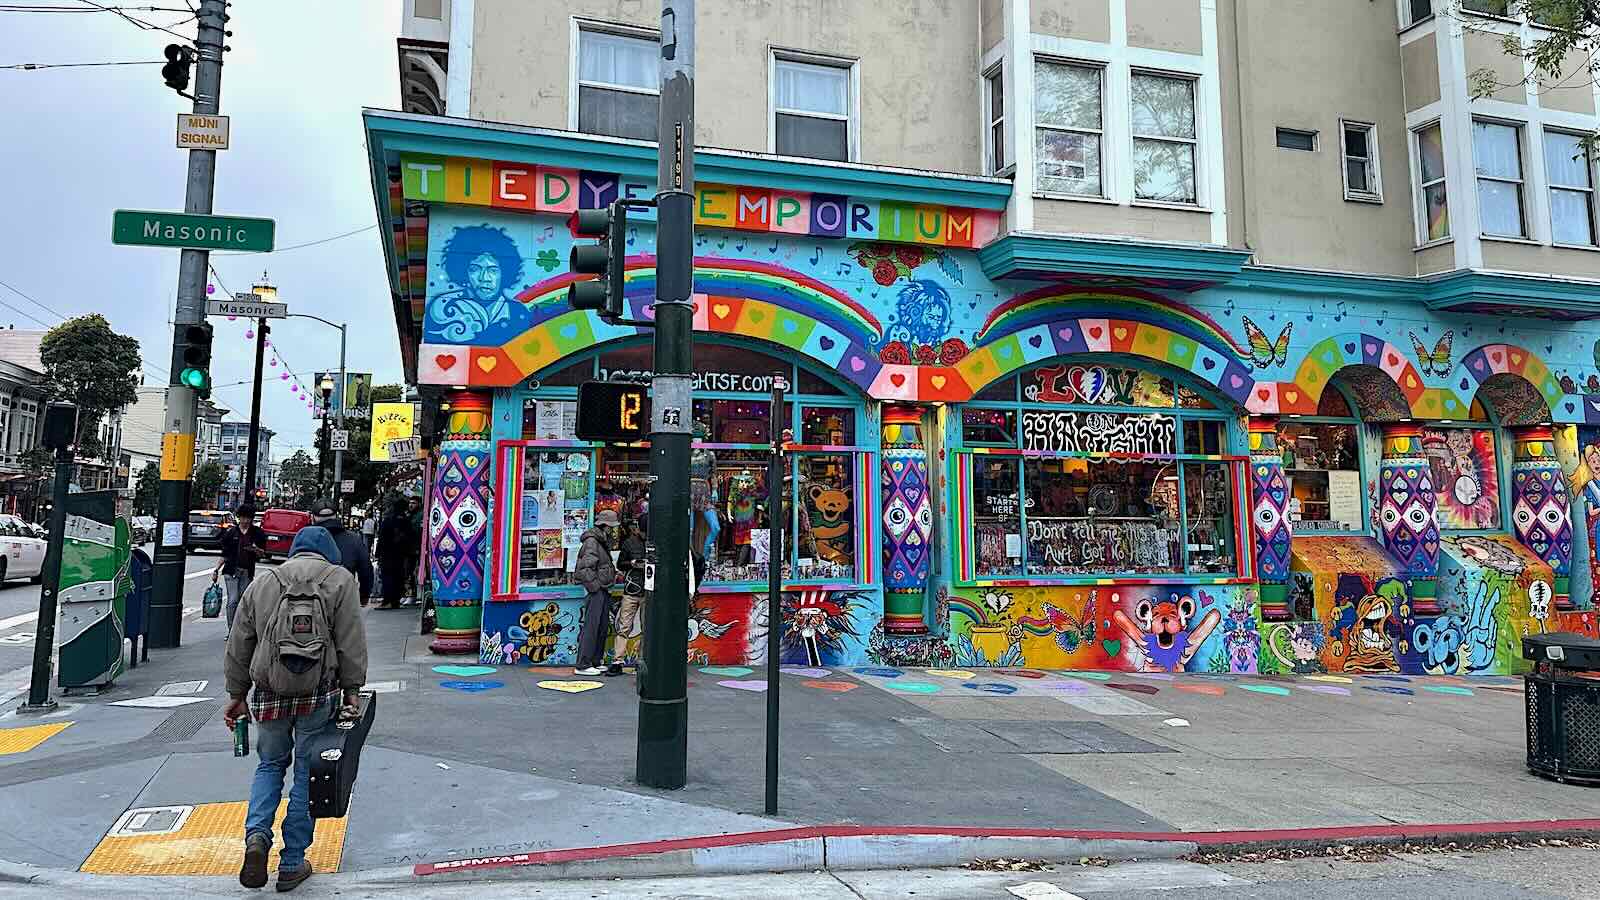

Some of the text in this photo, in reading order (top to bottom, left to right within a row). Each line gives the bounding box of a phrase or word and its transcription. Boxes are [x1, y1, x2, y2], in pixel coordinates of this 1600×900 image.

[188, 117, 218, 129] MUNI
[180, 133, 225, 145] SIGNAL
[700, 188, 975, 243] EMPORIUM
[143, 219, 247, 244] Masonic
[219, 303, 275, 315] Masonic
[620, 393, 641, 430] 12
[332, 440, 346, 448] 20
[1023, 412, 1176, 464] HAIGHT
[992, 505, 1013, 514] HERE
